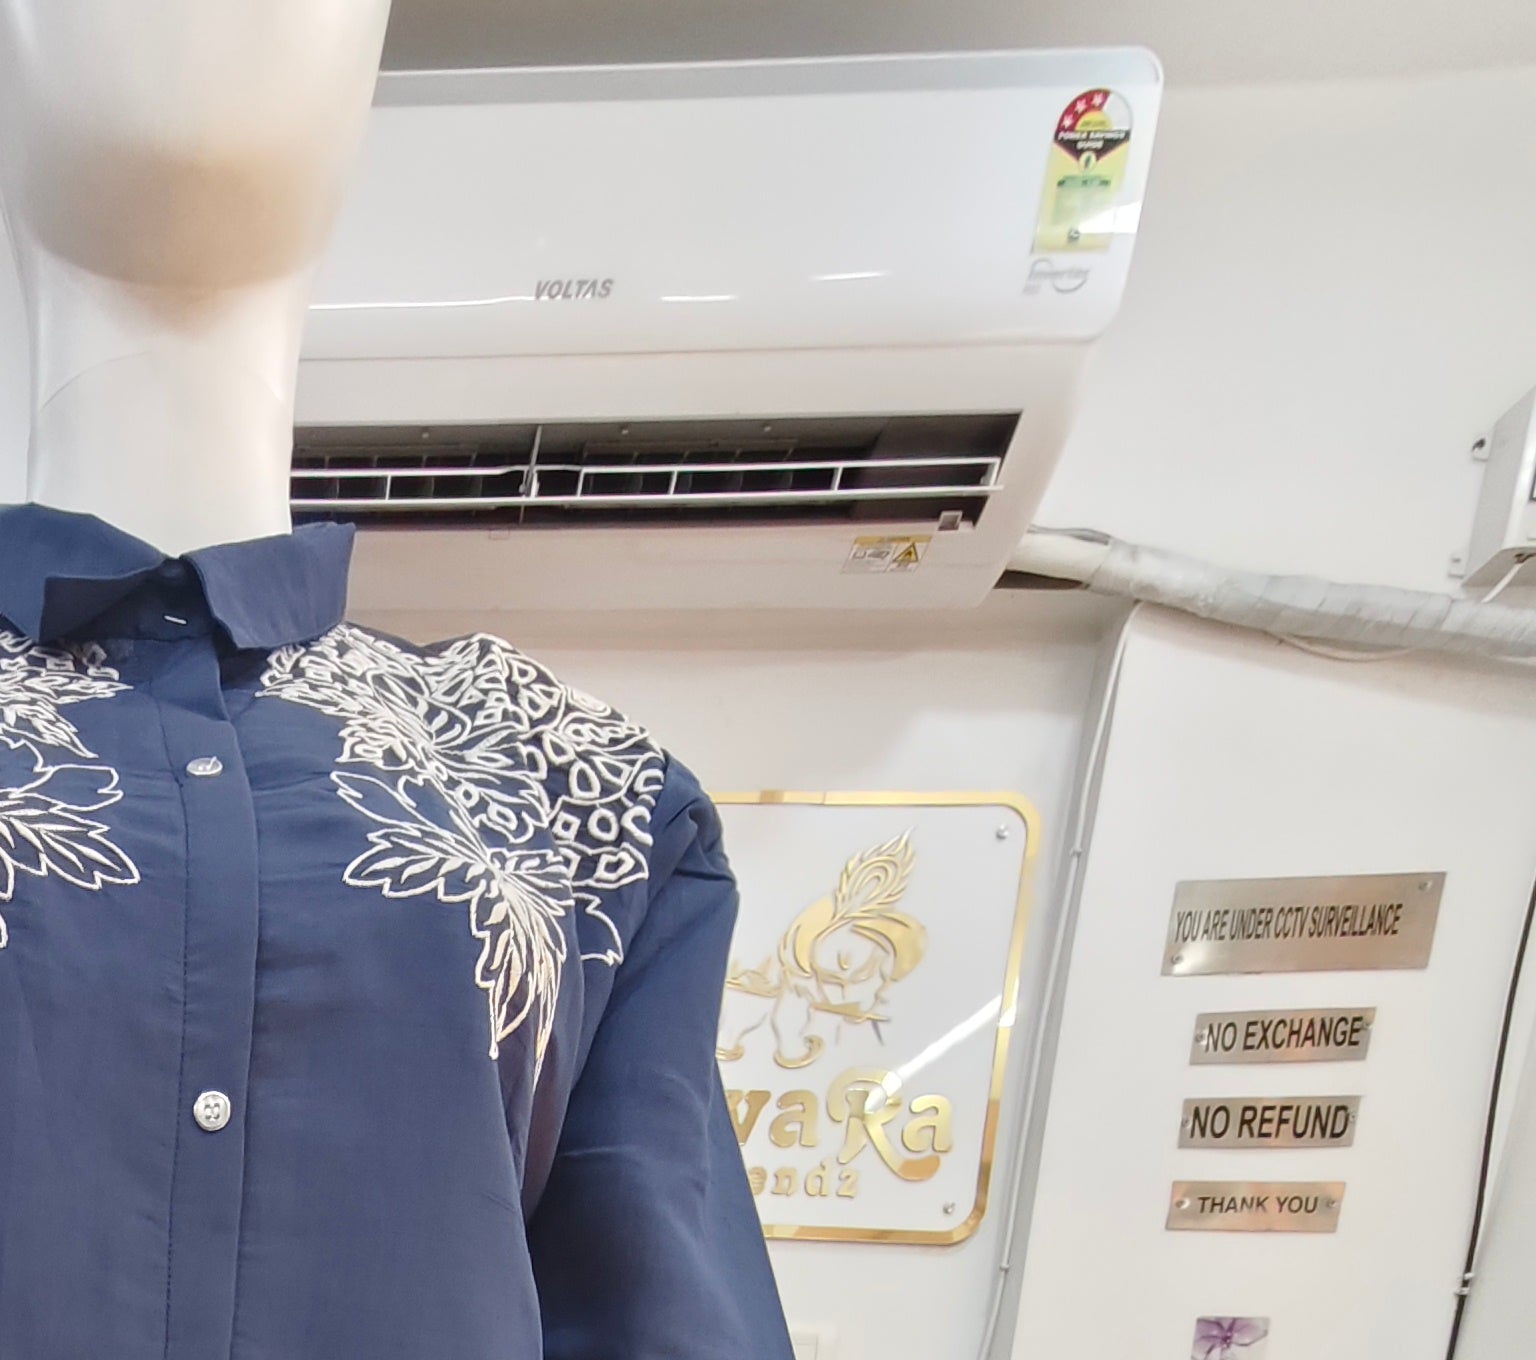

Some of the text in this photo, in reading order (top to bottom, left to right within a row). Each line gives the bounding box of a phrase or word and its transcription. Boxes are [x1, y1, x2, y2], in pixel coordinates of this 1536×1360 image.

[535, 278, 614, 299] VOLTAS
[1175, 910, 1202, 943] YOU
[1203, 909, 1229, 940] ARE
[1229, 907, 1273, 940] UNDER
[1274, 905, 1311, 938] CCTV
[1205, 1016, 1363, 1052] NO EXCHANGE
[1190, 1104, 1350, 1139] NO REFUND
[1197, 1196, 1319, 1214] THANK YOU
